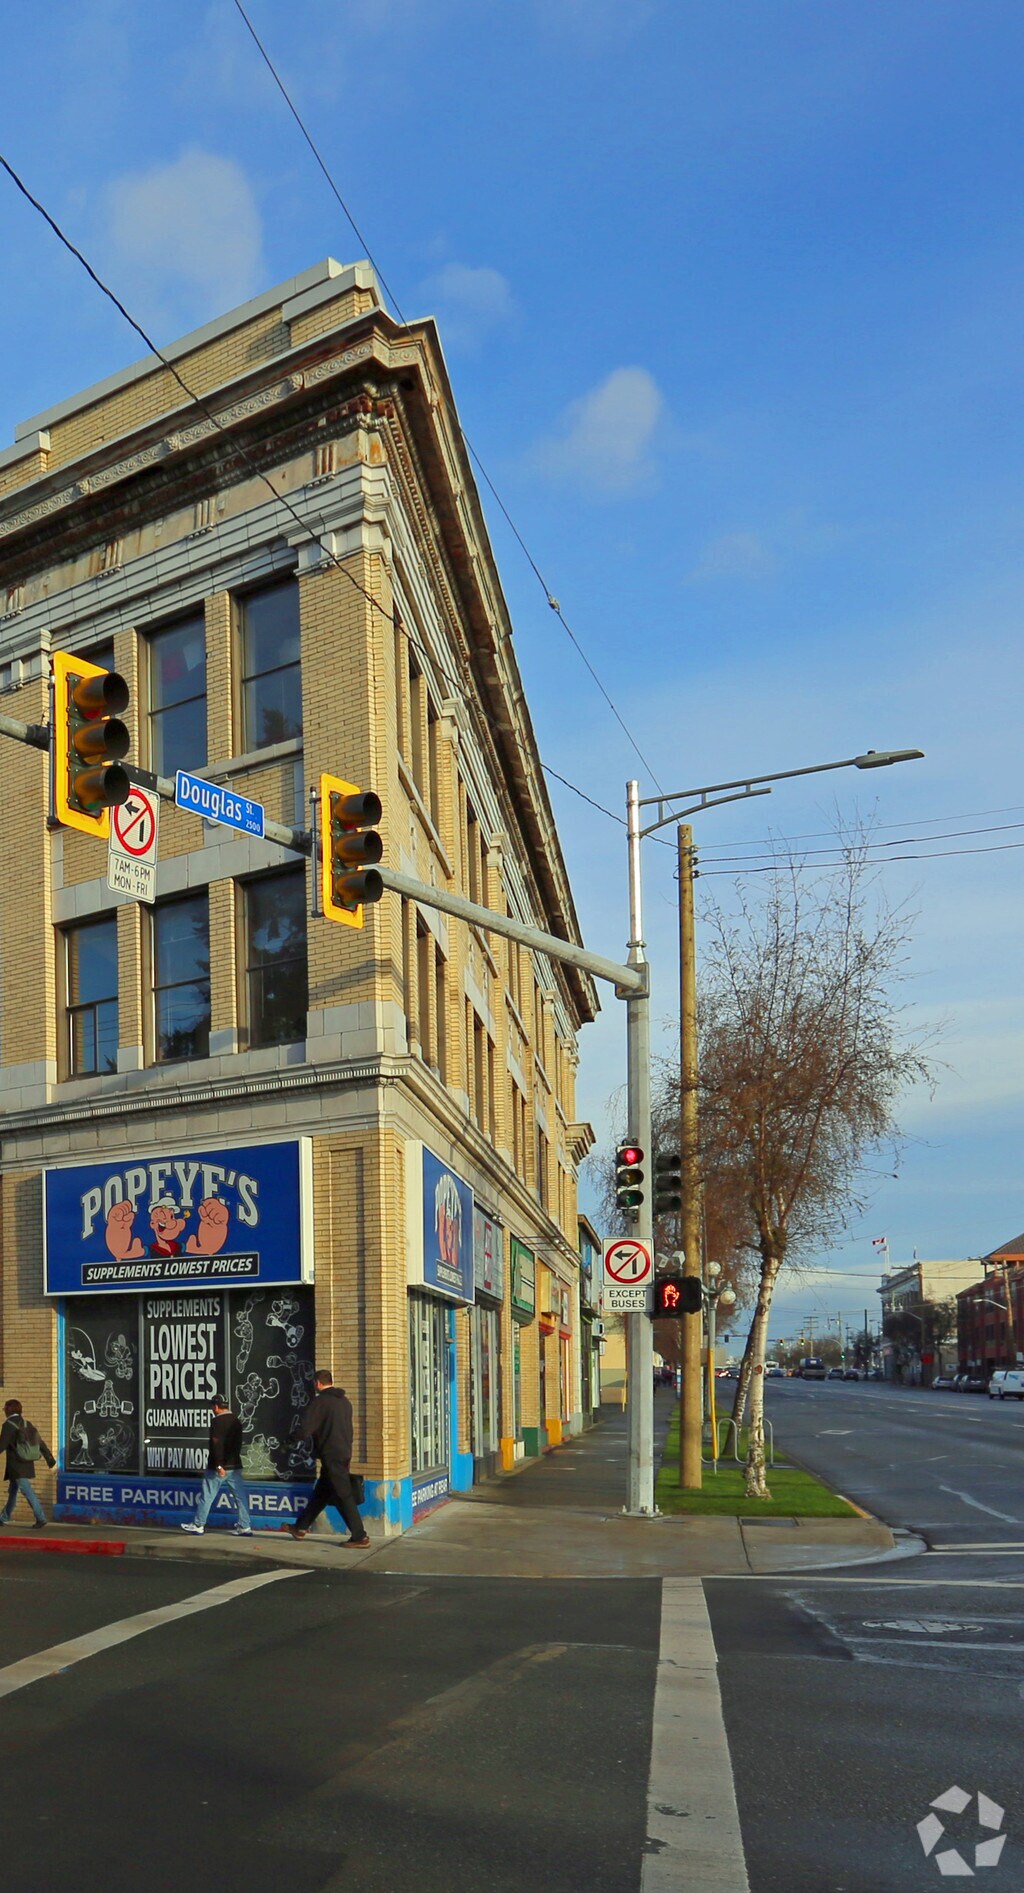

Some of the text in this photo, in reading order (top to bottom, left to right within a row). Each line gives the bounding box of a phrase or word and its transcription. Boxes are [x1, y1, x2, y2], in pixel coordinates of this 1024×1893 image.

[180, 776, 255, 822] Douglas St.
[246, 819, 261, 832] 2500
[82, 1161, 259, 1239] POPEYE'S
[87, 1258, 253, 1281] SUPPLEMENTS LOWEST PRICES
[609, 1290, 647, 1298] EXCEPT
[611, 1300, 645, 1308] BUSES
[146, 1297, 221, 1318] SUPPLEMENTS
[150, 1322, 217, 1361] LOWEST
[150, 1362, 218, 1401] PRICES
[147, 1446, 210, 1470] WHY PAY MOR
[65, 1485, 114, 1502] FREE
[249, 1494, 309, 1511] REAR
